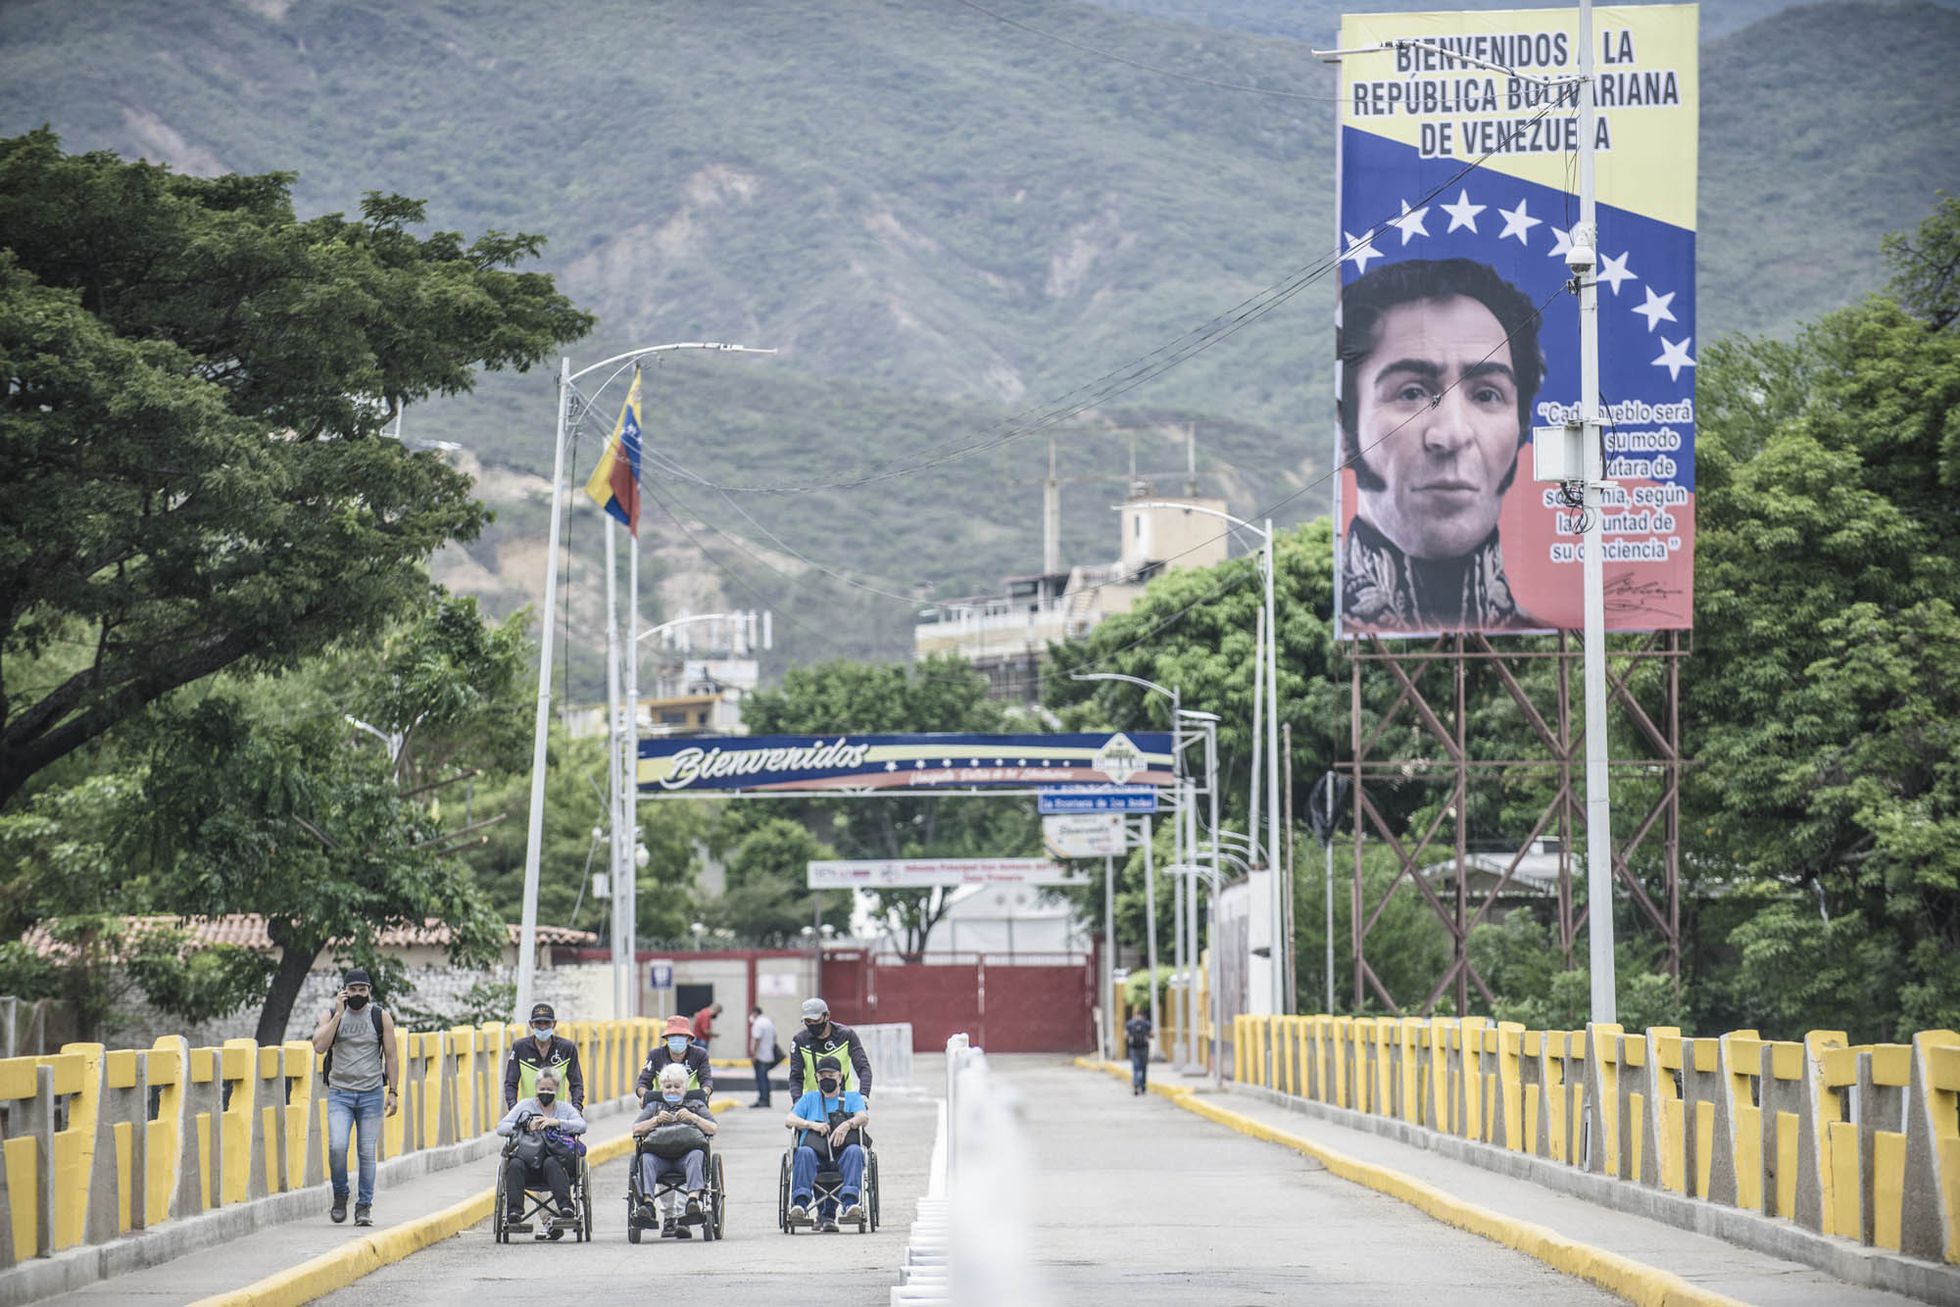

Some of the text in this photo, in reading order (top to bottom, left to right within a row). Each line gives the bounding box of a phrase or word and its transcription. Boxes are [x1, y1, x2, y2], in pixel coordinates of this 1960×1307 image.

[1397, 33, 1568, 72] BIENVENIDOS
[1603, 31, 1634, 64] LA
[1354, 73, 1498, 115] REPÚBLICA
[1421, 116, 1611, 155] DE VENEZUEA
[1540, 404, 1582, 422] “Cad
[1656, 400, 1690, 421] será
[1607, 429, 1679, 449] su modo
[1654, 456, 1674, 476] de
[1635, 483, 1685, 508] según
[1653, 512, 1673, 531] de
[1553, 546, 1572, 560] su
[659, 736, 869, 790] Bienvenidos
